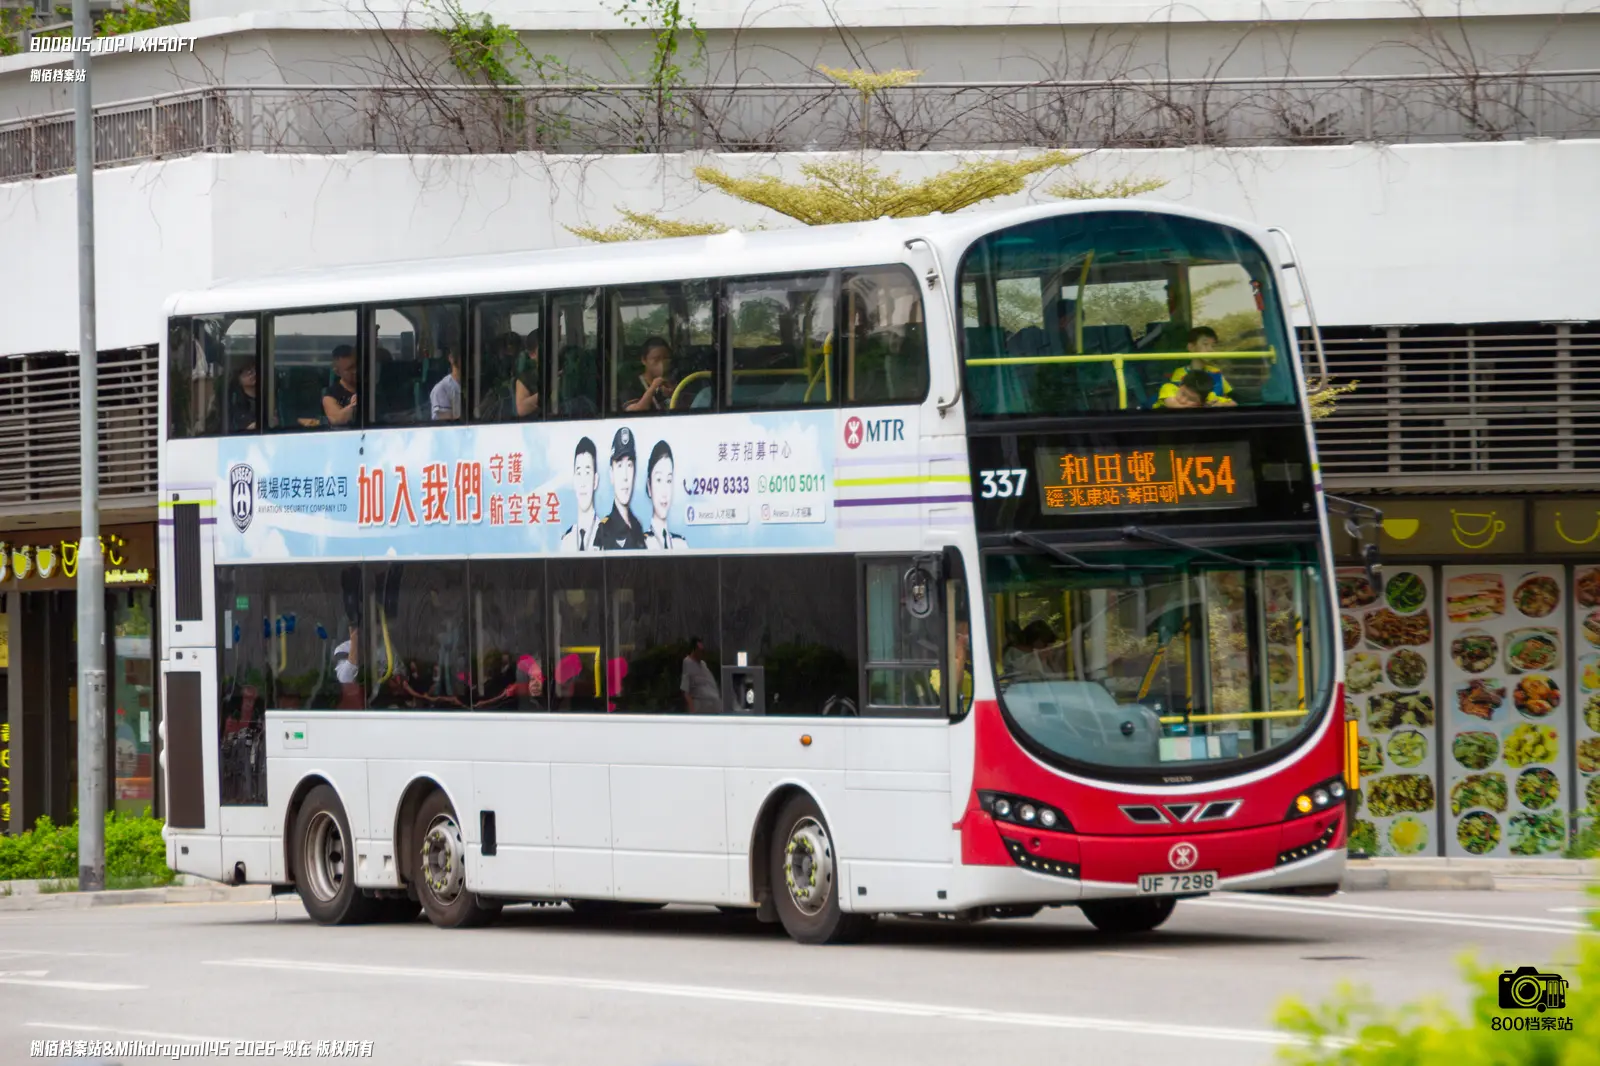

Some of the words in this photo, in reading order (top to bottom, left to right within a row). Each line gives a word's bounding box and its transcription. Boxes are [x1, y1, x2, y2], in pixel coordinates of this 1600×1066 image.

[866, 419, 905, 442] MTR
[717, 440, 792, 462] 葵芳招募中心
[489, 452, 523, 484] 守護
[1060, 451, 1156, 484] 和田邨
[1176, 455, 1236, 496] K54
[257, 476, 348, 498] 機場保安有限公司
[357, 461, 483, 525] 加入我們
[693, 477, 720, 496] 2949
[723, 475, 750, 494] 8333
[769, 475, 796, 493] 6010
[799, 474, 826, 492] 5011
[979, 468, 1028, 499] 337
[258, 505, 282, 514] AVIATION
[283, 505, 309, 514] SECURITY
[310, 504, 336, 512] COMPANY
[337, 504, 347, 512] LTD
[490, 492, 561, 525] 航空安全
[1162, 776, 1193, 784] VOLVO
[1142, 877, 1164, 892] UF
[1170, 874, 1214, 891] 7298
